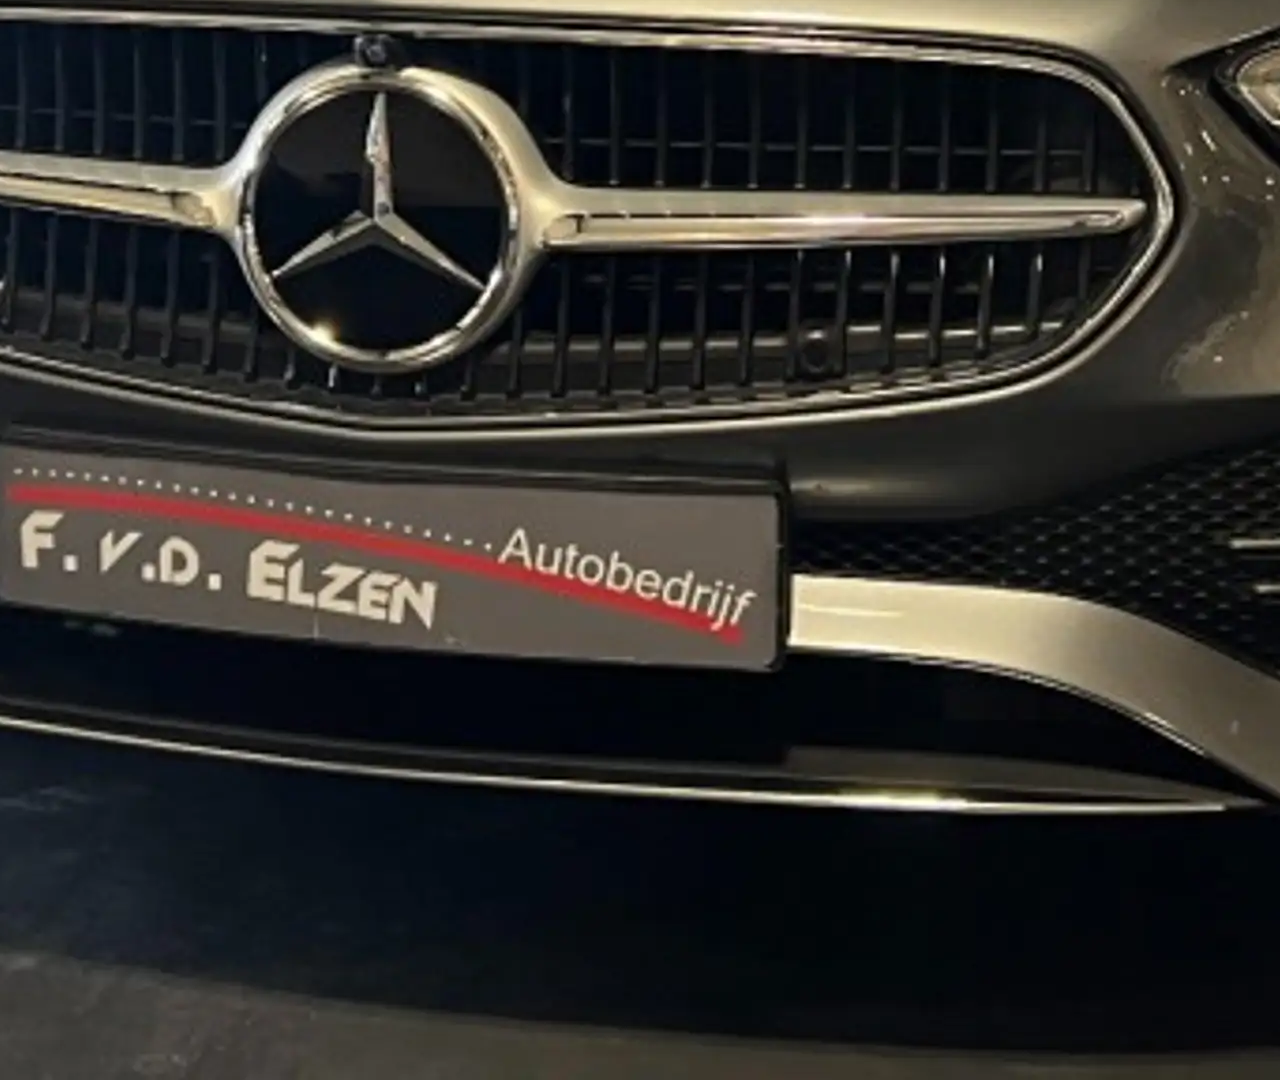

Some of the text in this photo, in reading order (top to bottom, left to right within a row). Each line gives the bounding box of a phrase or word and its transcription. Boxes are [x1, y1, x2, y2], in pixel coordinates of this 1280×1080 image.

[20, 509, 78, 572] F.
[246, 539, 438, 630] ELZEN
[498, 527, 757, 631] Autobedrijf
